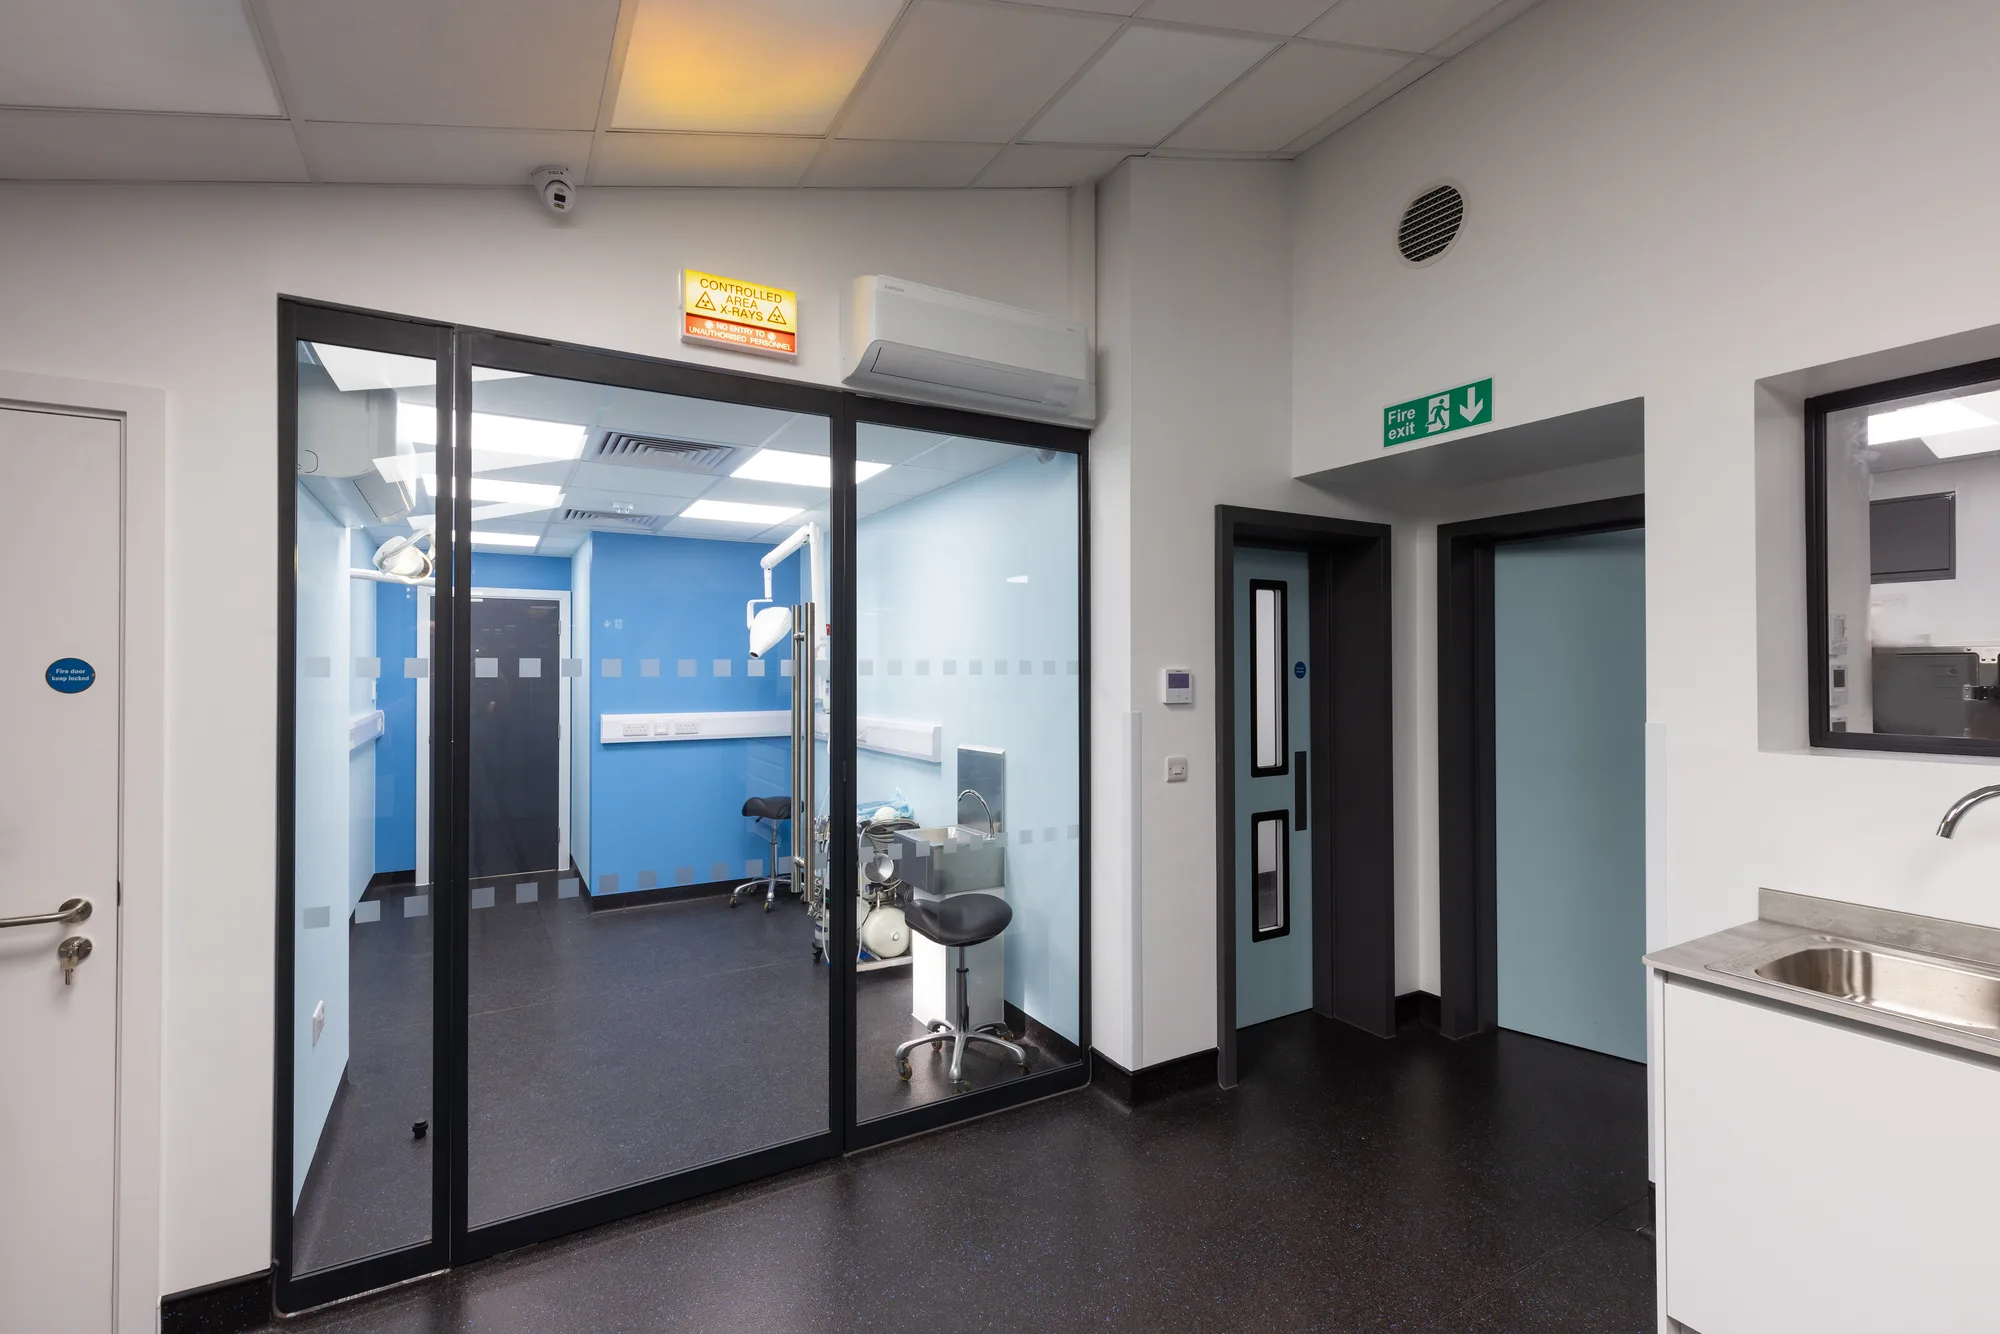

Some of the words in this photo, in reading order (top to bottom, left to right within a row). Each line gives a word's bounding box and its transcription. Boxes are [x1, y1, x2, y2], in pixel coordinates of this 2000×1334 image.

[700, 278, 783, 303] CONTROLLED
[725, 295, 758, 310] AREA
[720, 304, 763, 321] X-RAYS
[688, 326, 746, 342] UNAUTHORISED
[750, 336, 792, 351] PERSONNEL
[716, 322, 728, 331] NO
[730, 325, 754, 337] ENTRY
[754, 328, 765, 338] TO
[1388, 408, 1416, 425] Fire
[1388, 421, 1415, 440] exit
